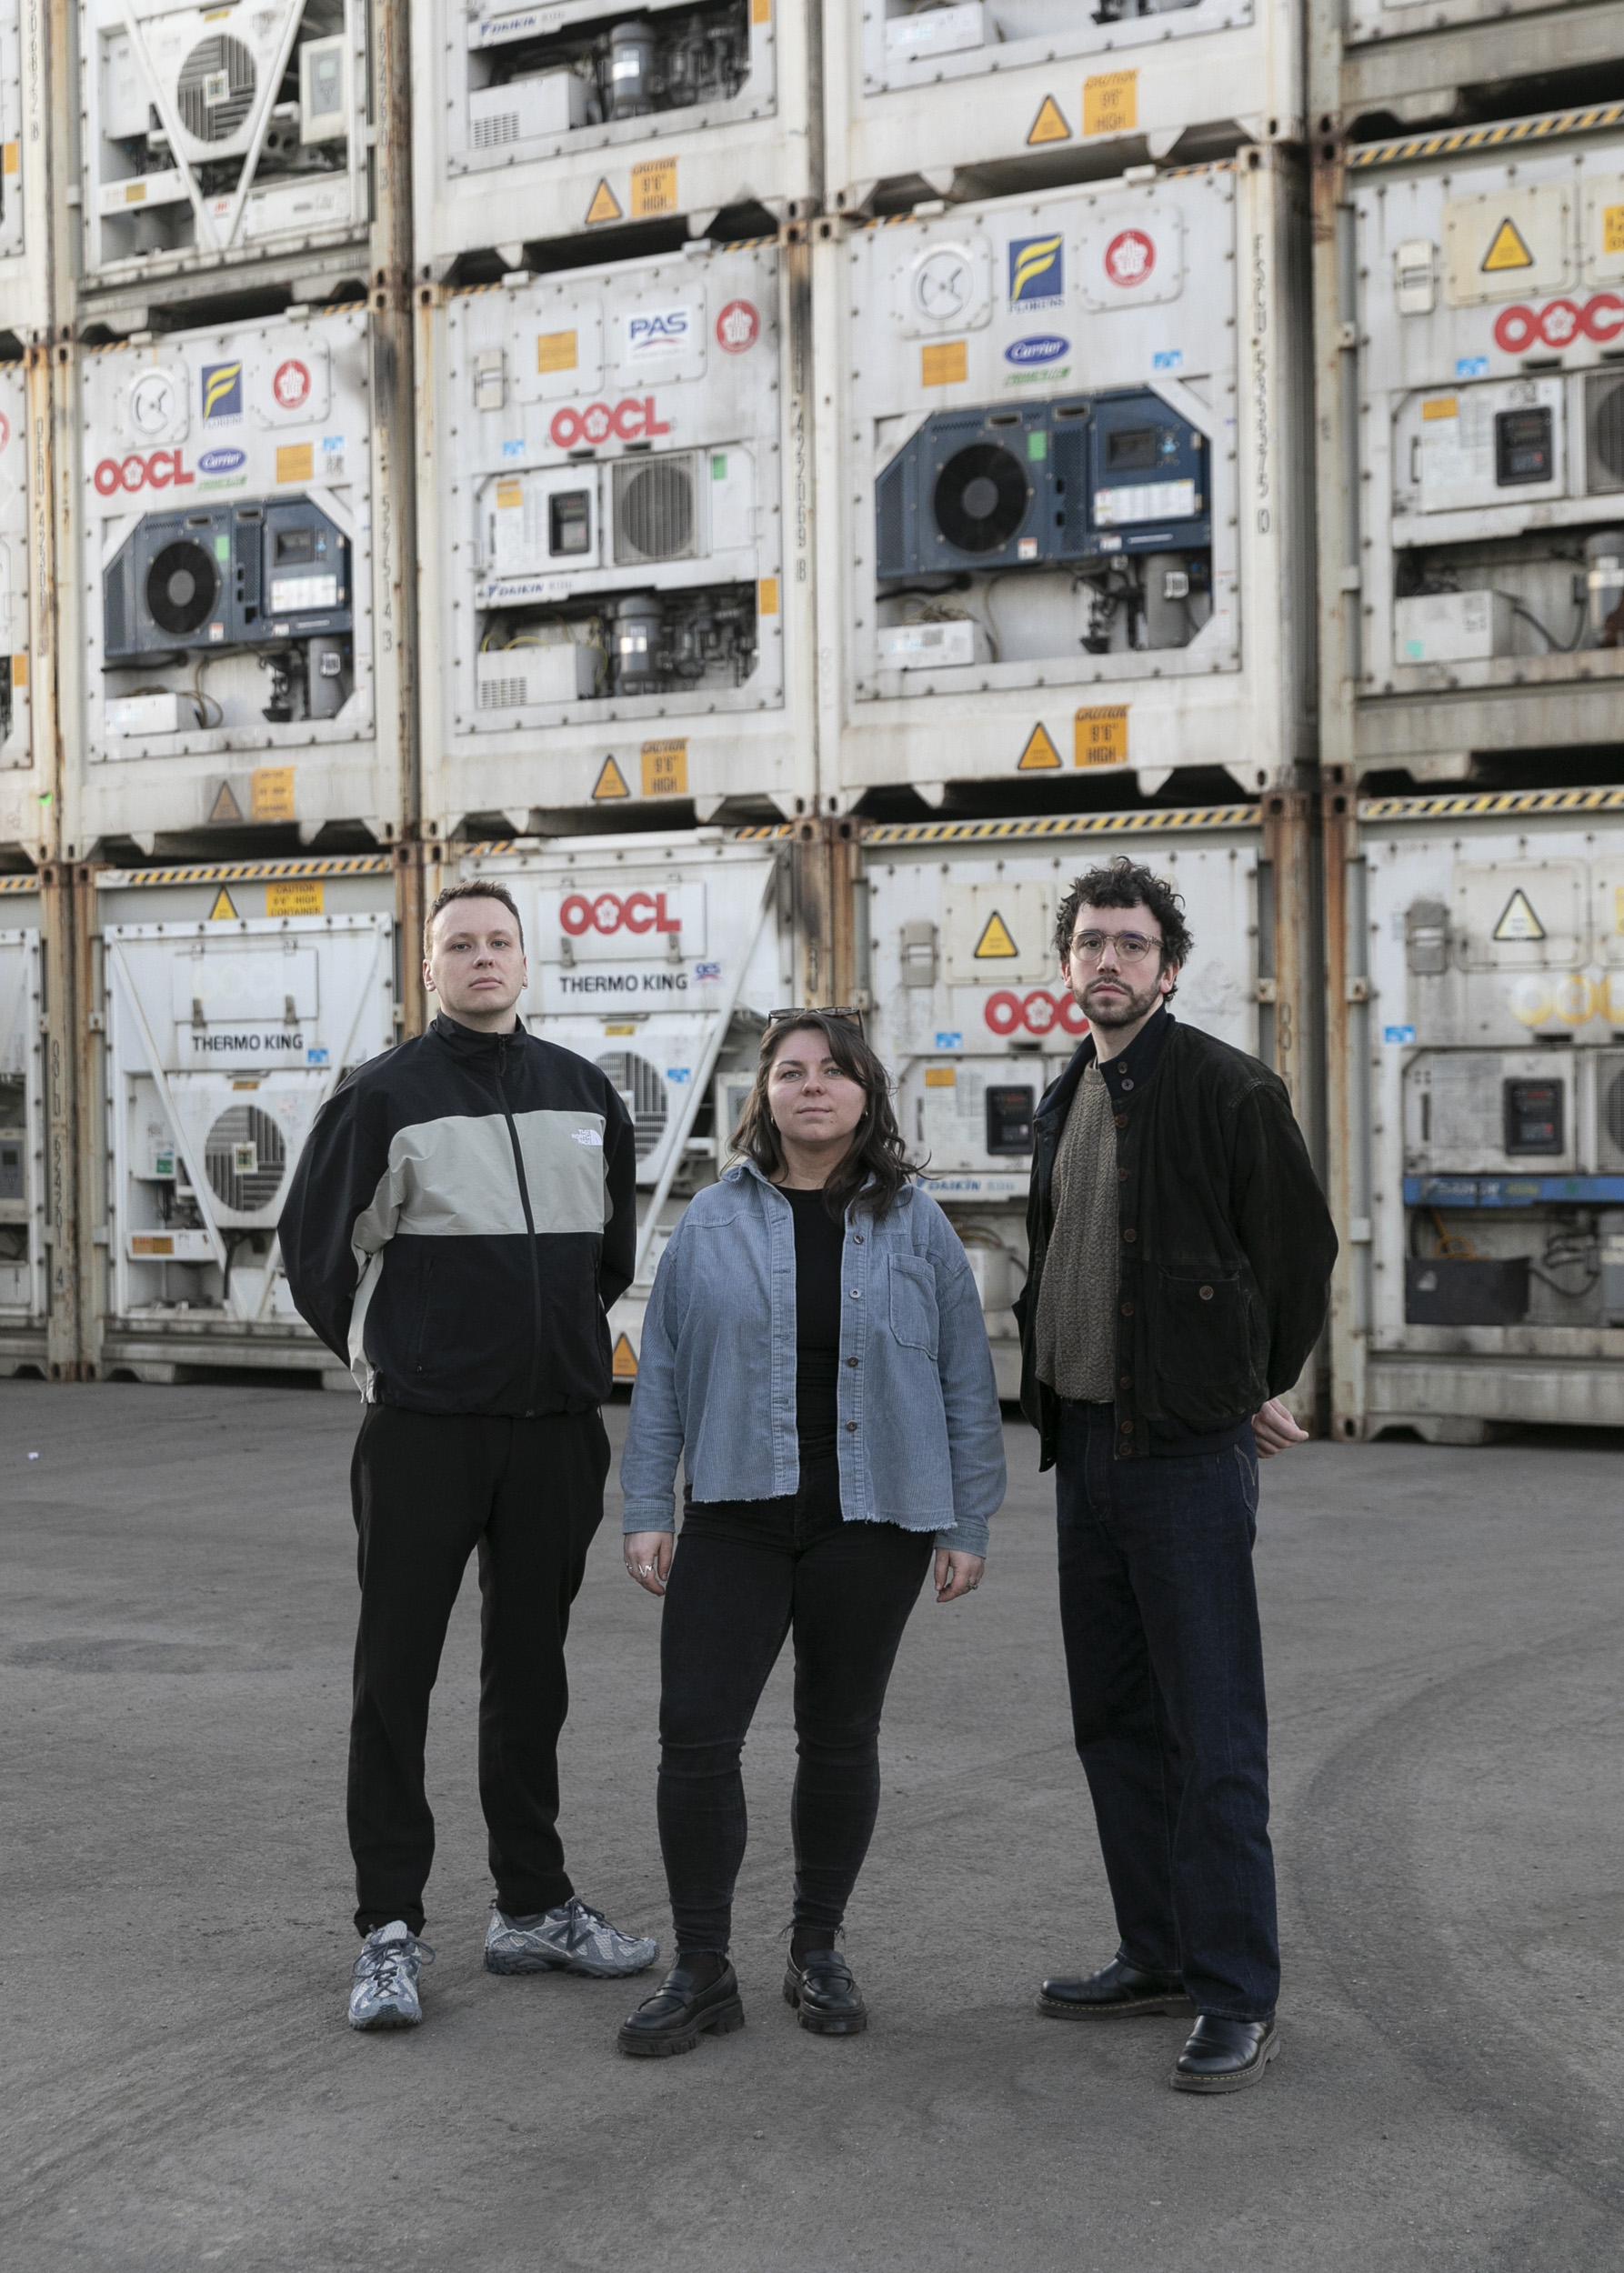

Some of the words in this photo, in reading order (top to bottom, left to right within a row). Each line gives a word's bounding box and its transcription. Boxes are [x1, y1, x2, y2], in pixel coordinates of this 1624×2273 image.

[642, 195, 667, 211] HIGH
[1009, 299, 1063, 313] FLORENS
[630, 312, 687, 340] PAS
[1494, 293, 1624, 353] OOC
[1011, 339, 1063, 360] Carrier
[203, 415, 244, 429] FLORENS
[550, 396, 670, 447] OOCL
[204, 451, 241, 469] Carrier
[94, 447, 195, 496] OOCL
[1087, 746, 1117, 764] HIGH
[652, 776, 677, 793] HIGH
[276, 883, 315, 895] CAUTION
[296, 895, 316, 905] HIGH
[270, 906, 321, 916] CONTAINER
[559, 892, 682, 936] OOCL
[559, 975, 638, 993] THERMO
[643, 974, 687, 990] KING
[985, 990, 1090, 1035] OOC
[192, 1035, 260, 1051] THERMO
[265, 1034, 303, 1050] KING
[928, 1179, 981, 1190] DAIKIN
